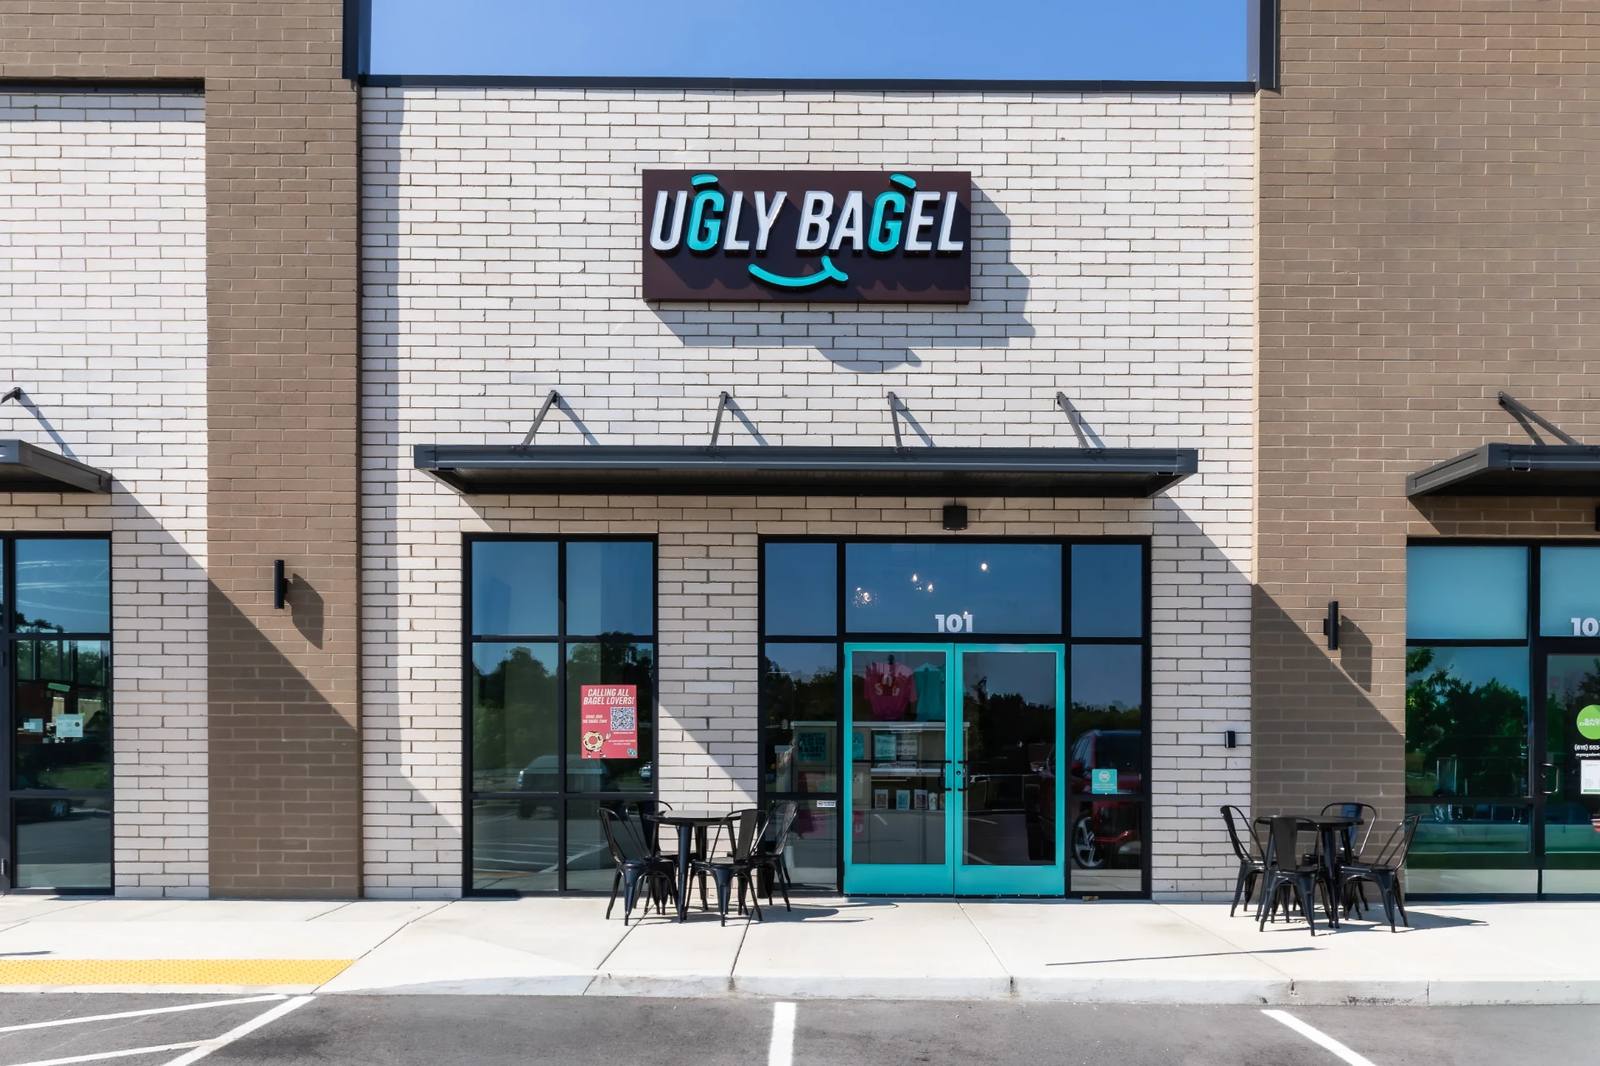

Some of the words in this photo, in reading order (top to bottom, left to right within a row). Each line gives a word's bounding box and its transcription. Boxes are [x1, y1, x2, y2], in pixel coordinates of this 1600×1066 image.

[649, 190, 787, 251] UGLY
[795, 190, 964, 252] BAGEL
[934, 614, 973, 633] 101
[1570, 617, 1600, 637] 10
[583, 696, 605, 705] BAGEL
[606, 696, 635, 705] LOVERS!
[587, 688, 617, 697] CALLING
[617, 688, 630, 697] ALL
